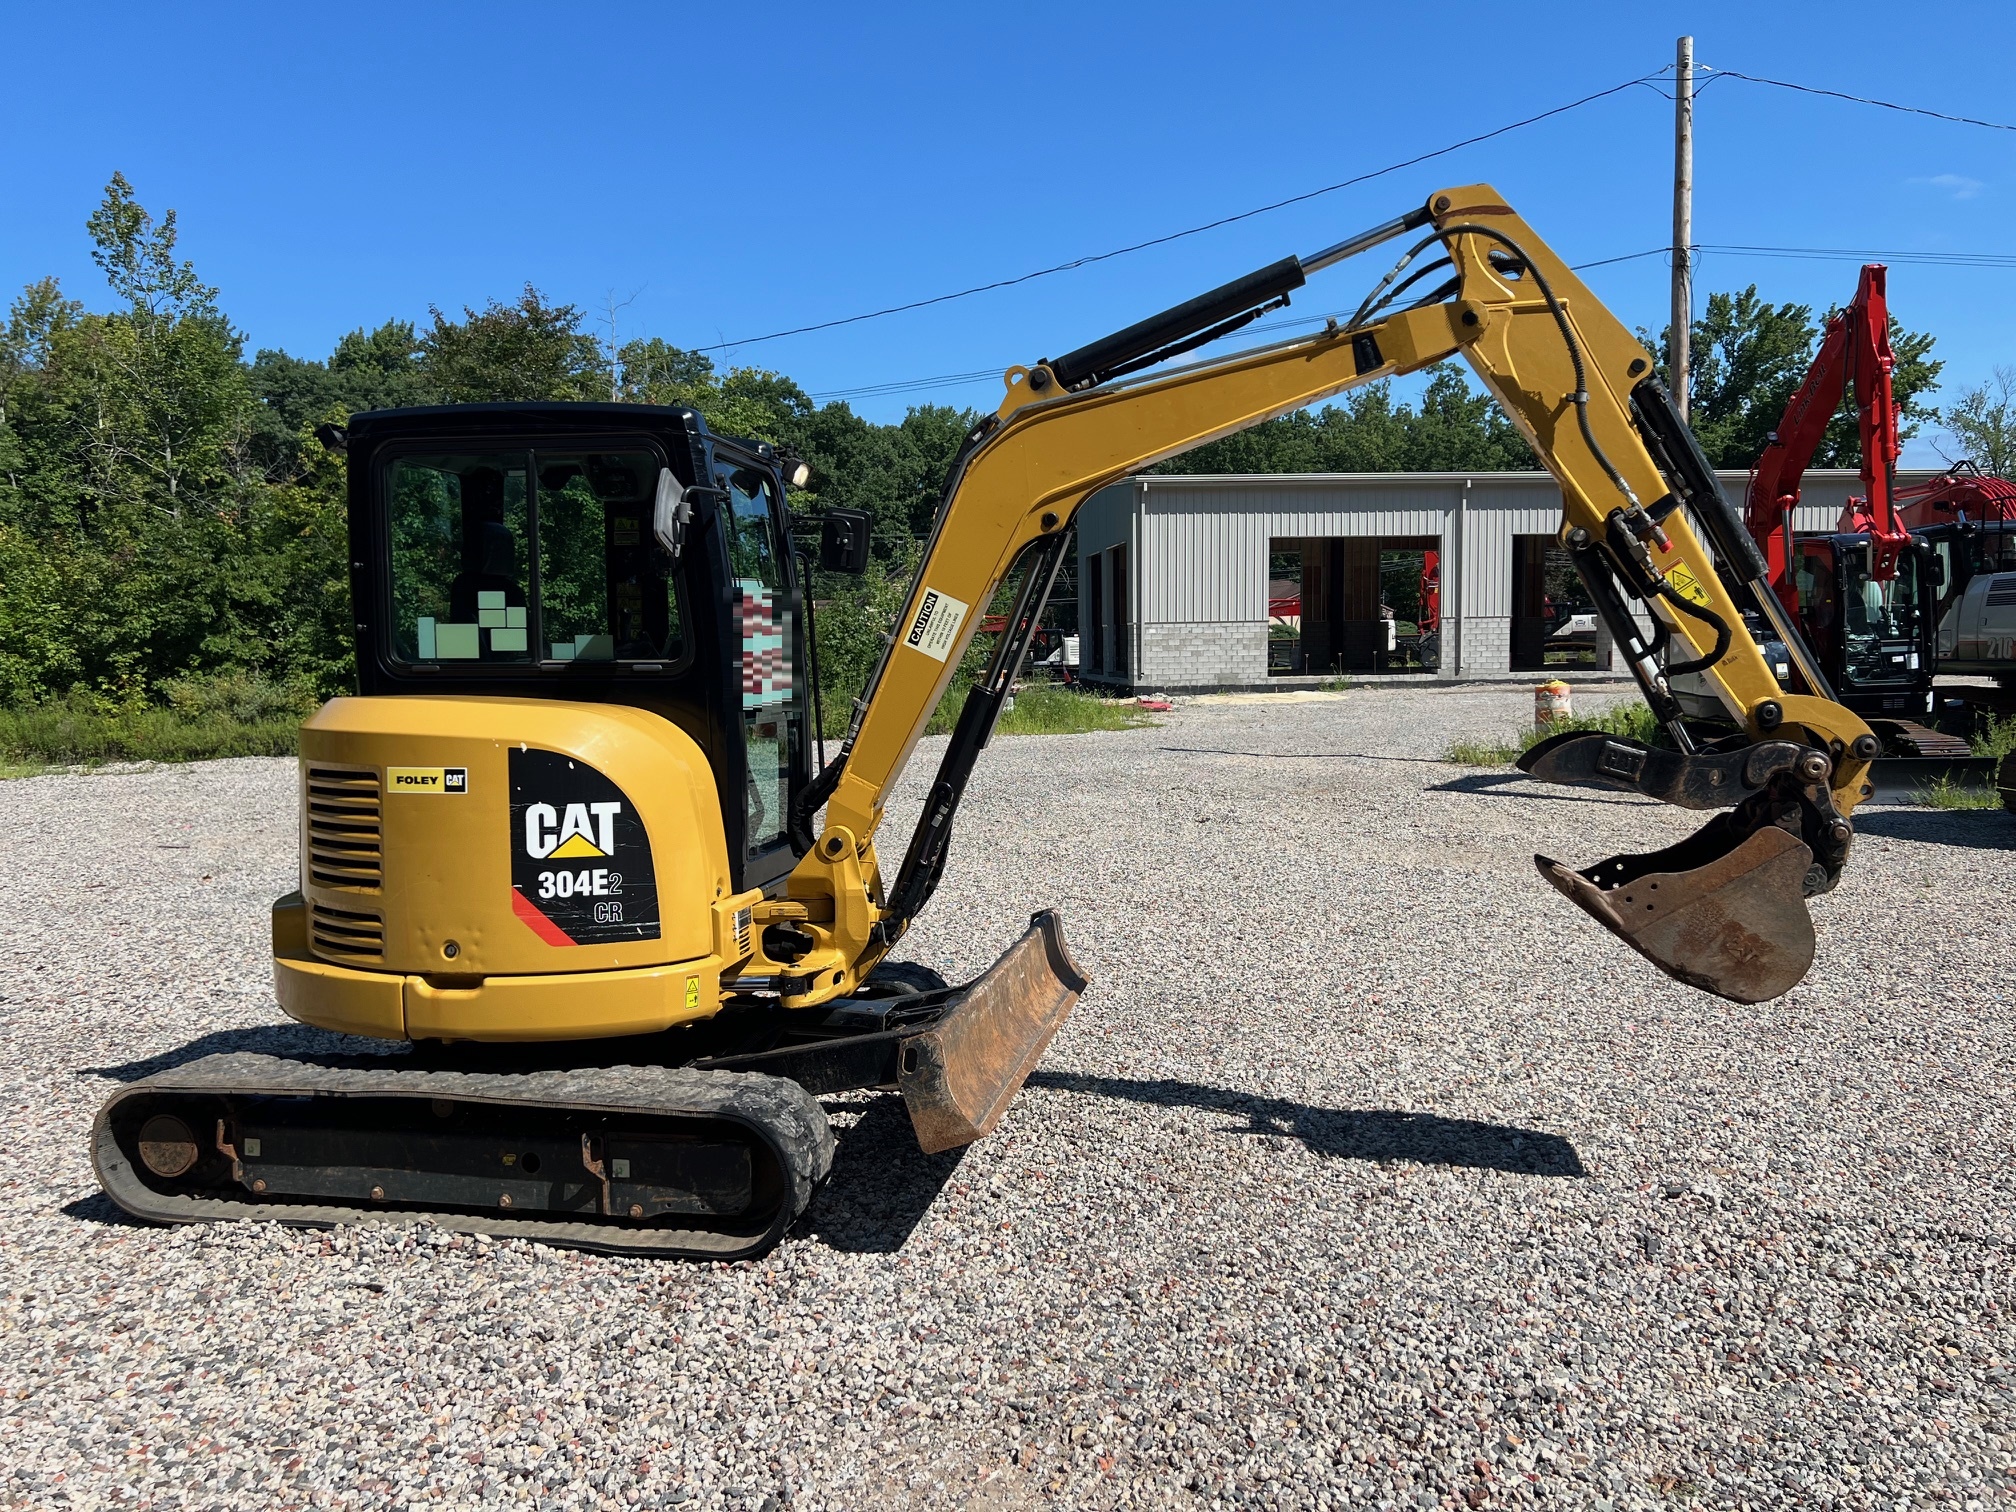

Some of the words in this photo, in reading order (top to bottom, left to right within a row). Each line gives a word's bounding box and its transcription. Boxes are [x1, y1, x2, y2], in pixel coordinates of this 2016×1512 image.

[911, 595, 936, 642] CAUTION
[927, 632, 937, 649] OPERATE
[938, 603, 949, 624] EQUIPMENT
[945, 624, 954, 640] VOLTAGE
[396, 776, 438, 785] FOLEY
[445, 774, 464, 786] CAT
[525, 801, 621, 859] CAT
[538, 868, 623, 899] 304E2
[594, 901, 623, 923] CR
